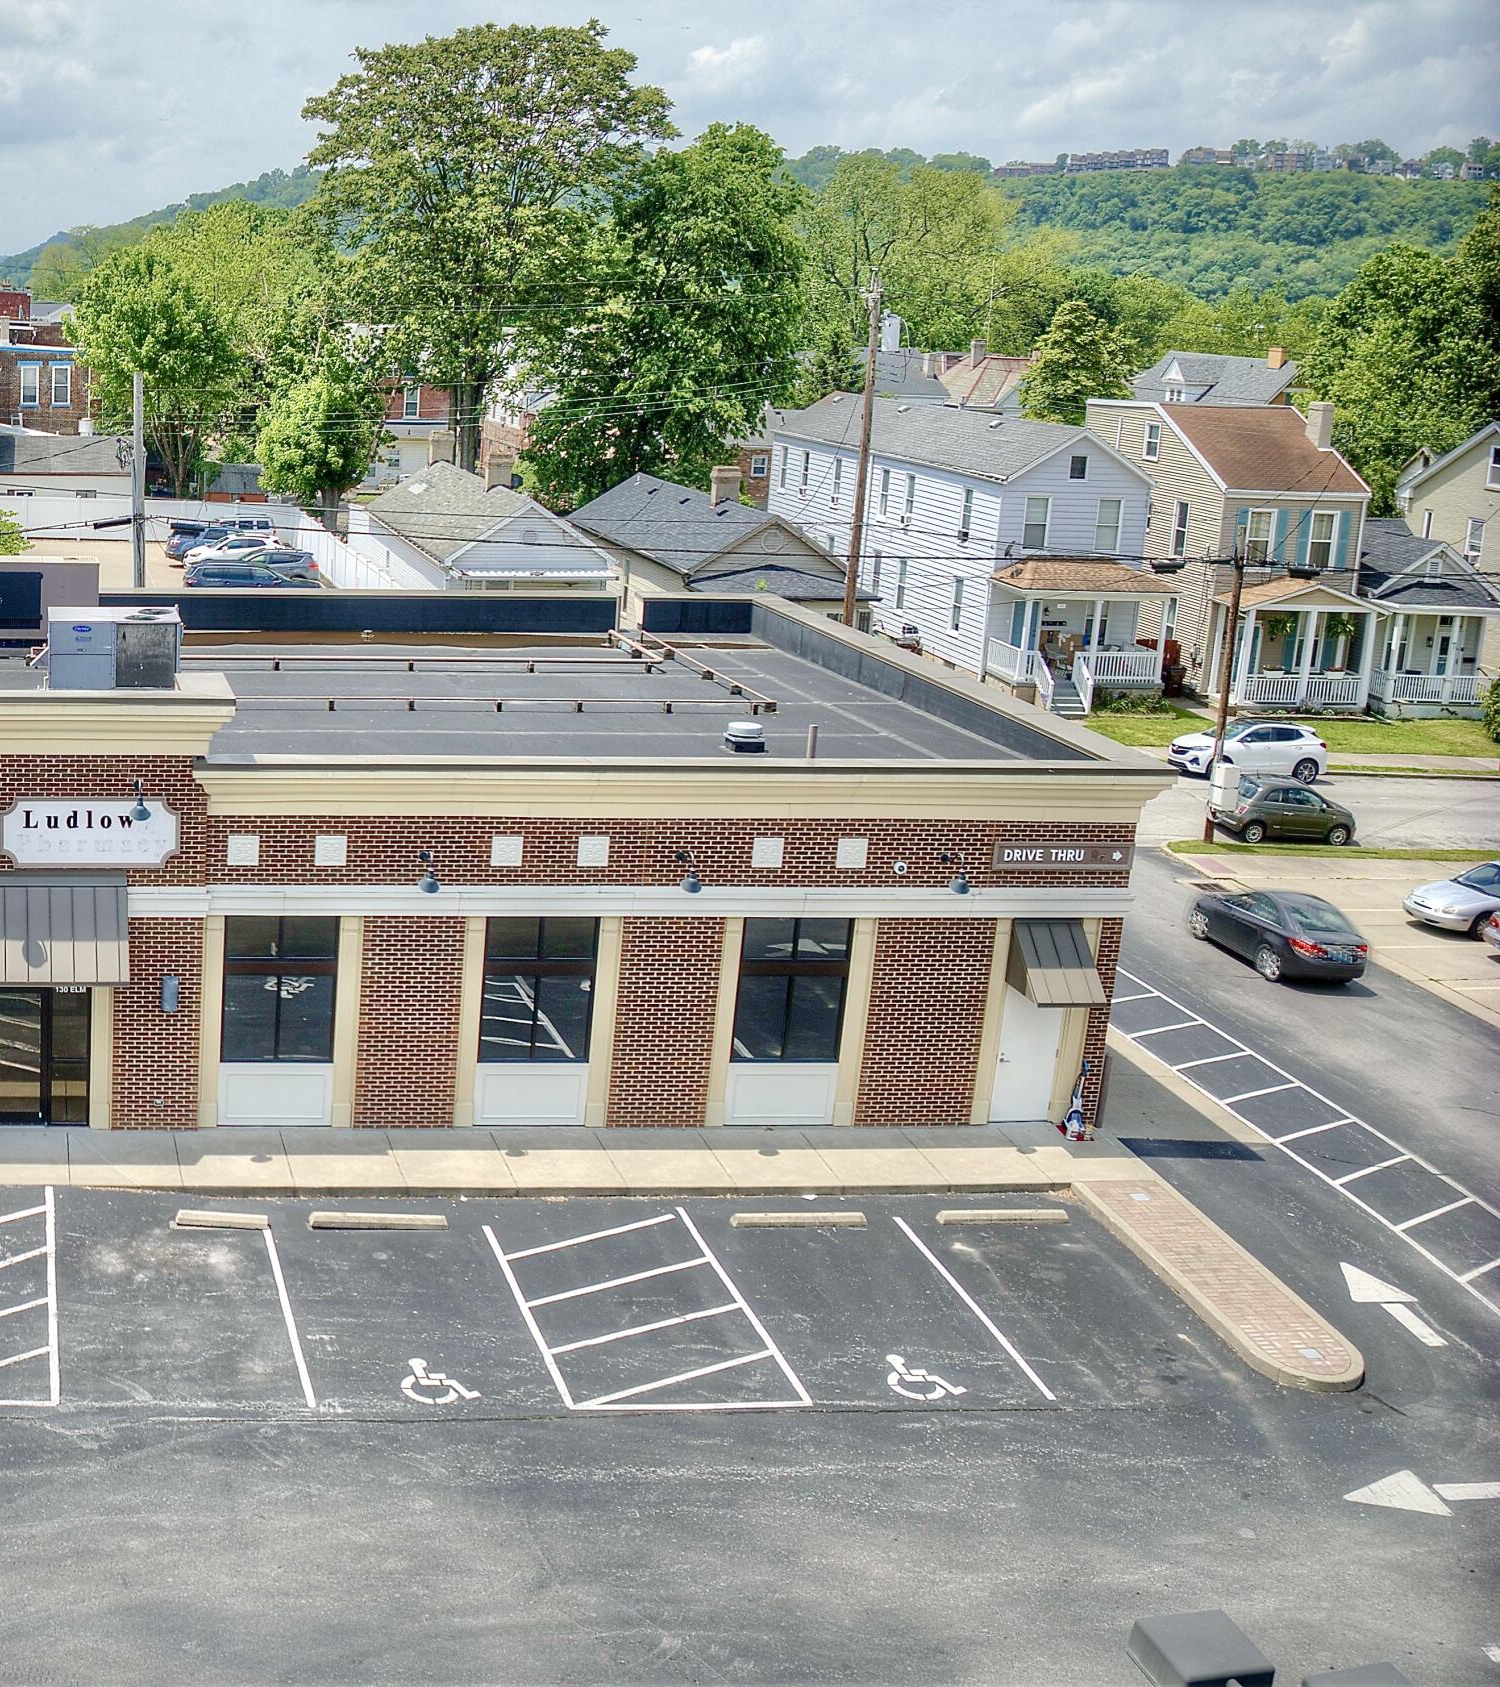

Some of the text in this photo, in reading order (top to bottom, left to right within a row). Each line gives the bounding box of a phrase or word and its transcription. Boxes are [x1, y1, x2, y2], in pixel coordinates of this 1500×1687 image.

[22, 810, 134, 829] Ludlow
[1003, 849, 1044, 862] DRIVE
[1050, 849, 1085, 862] THRU
